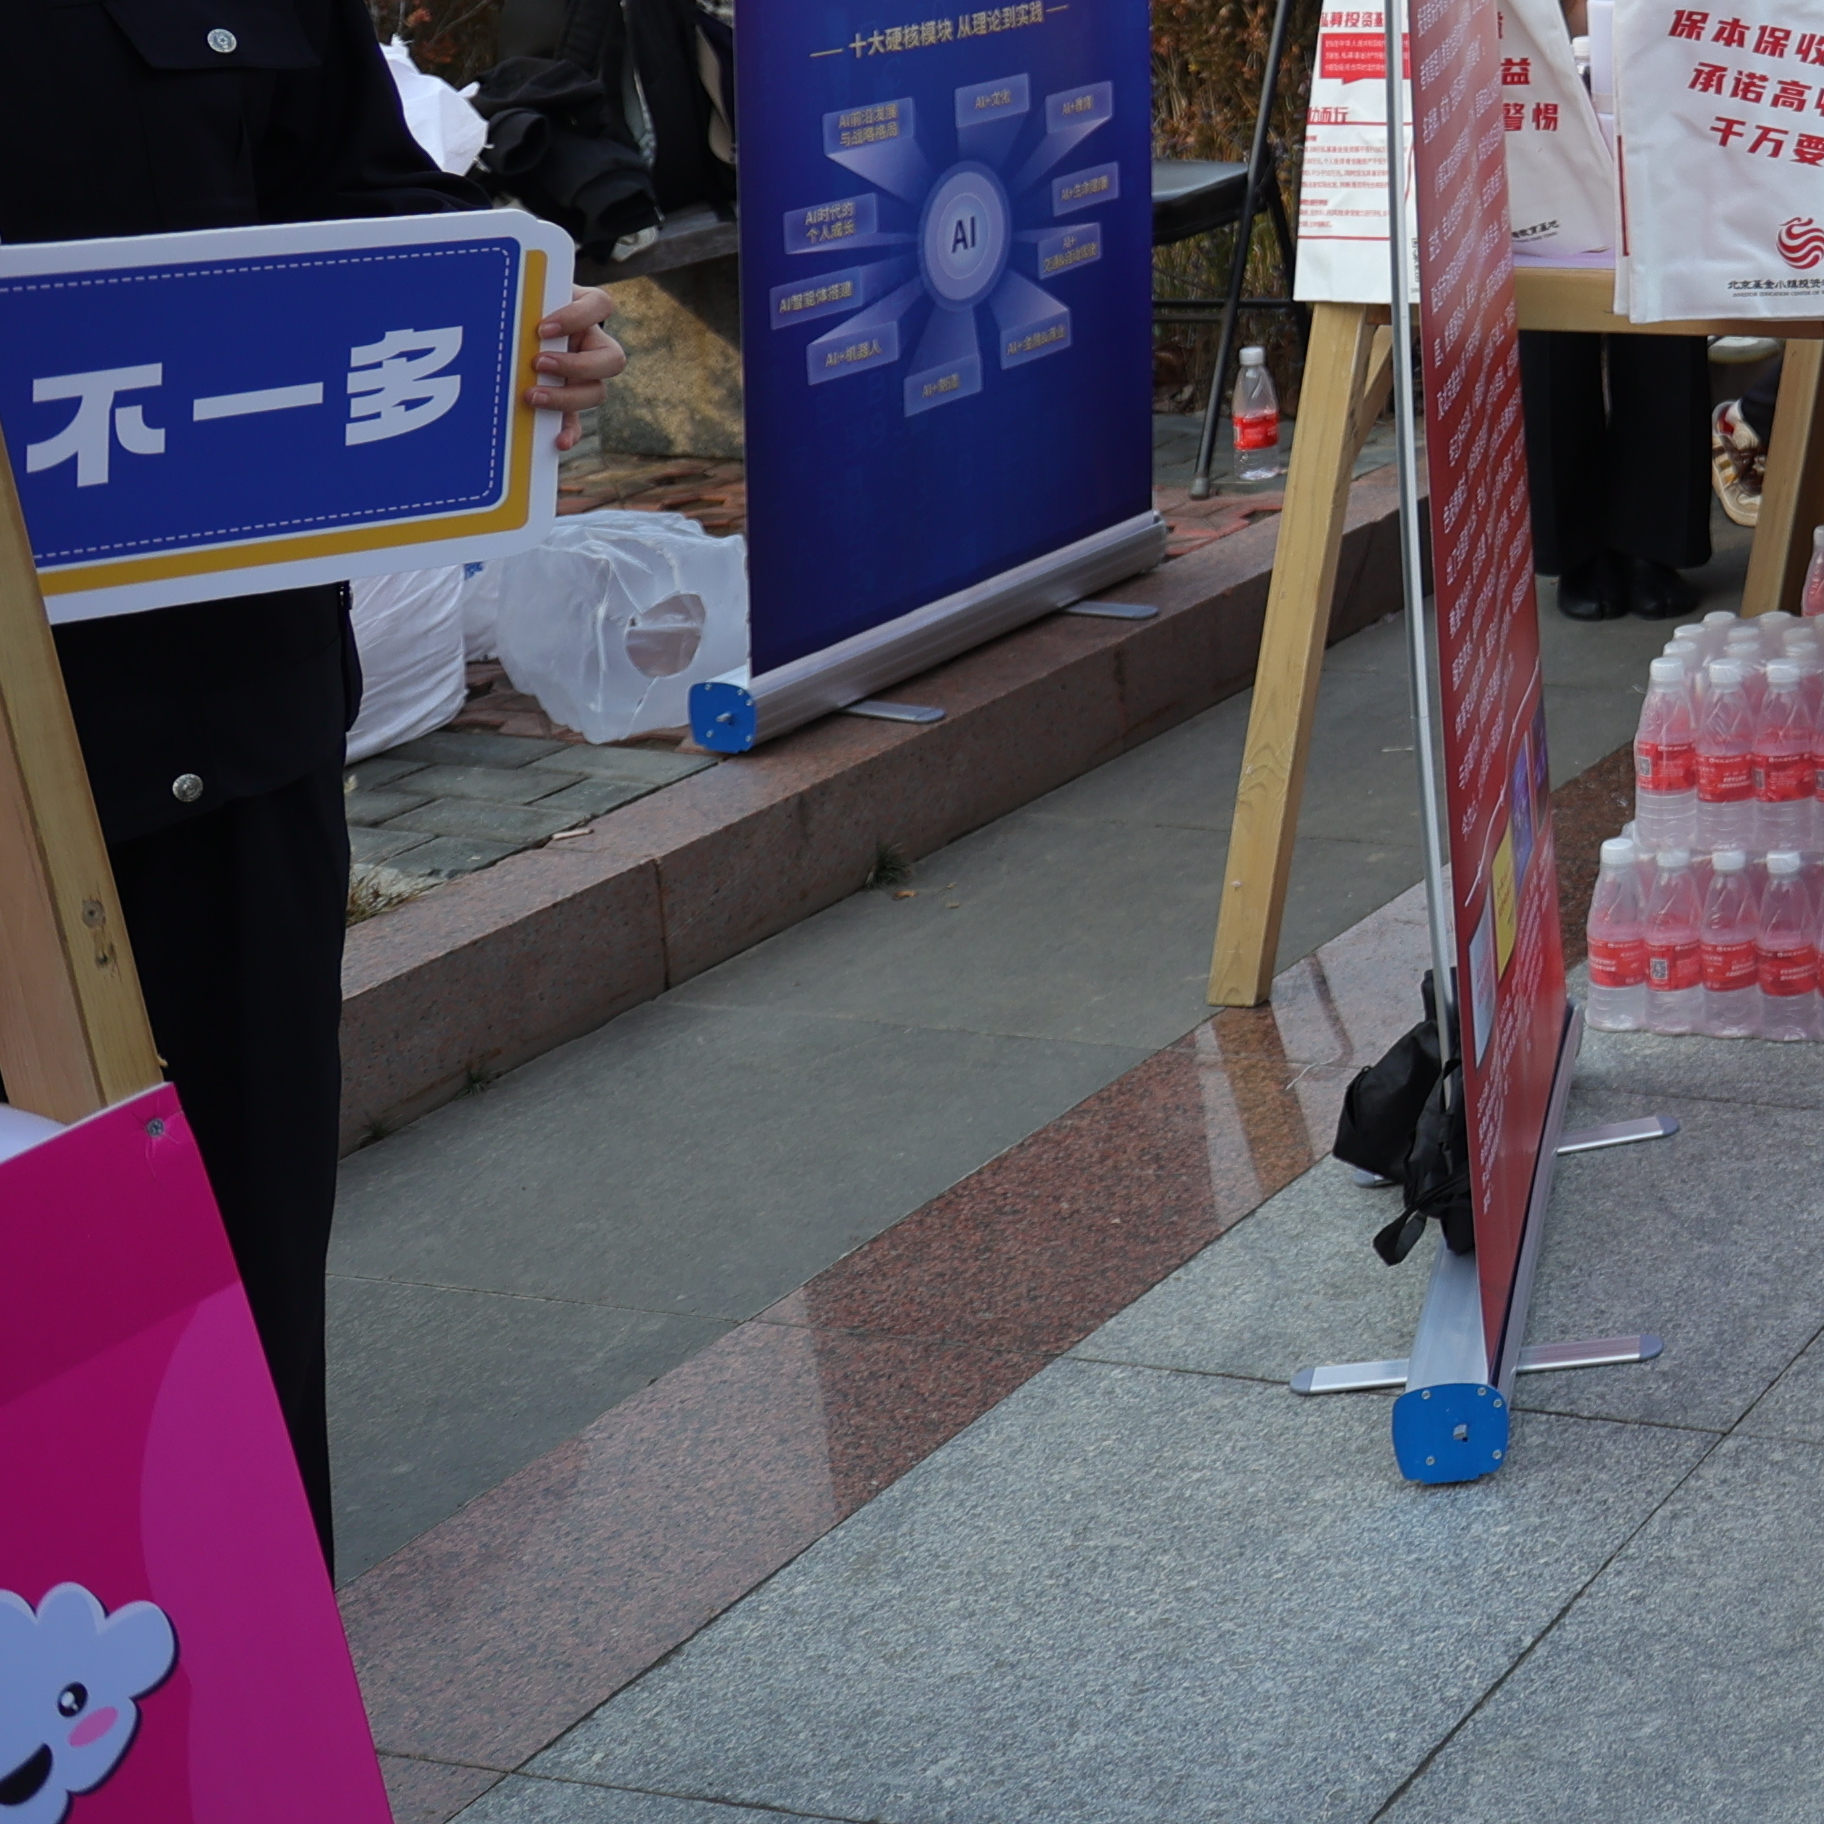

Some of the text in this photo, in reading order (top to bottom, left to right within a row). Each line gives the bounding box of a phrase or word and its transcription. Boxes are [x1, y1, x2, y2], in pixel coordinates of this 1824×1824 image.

[848, 0, 1044, 60] 十大硬核模块 从理论到实践
[1501, 57, 1531, 86] 益
[1503, 102, 1559, 132] 警惕
[951, 215, 977, 255] AI
[825, 340, 882, 367] AI+机器人
[26, 325, 464, 488] 不一多
